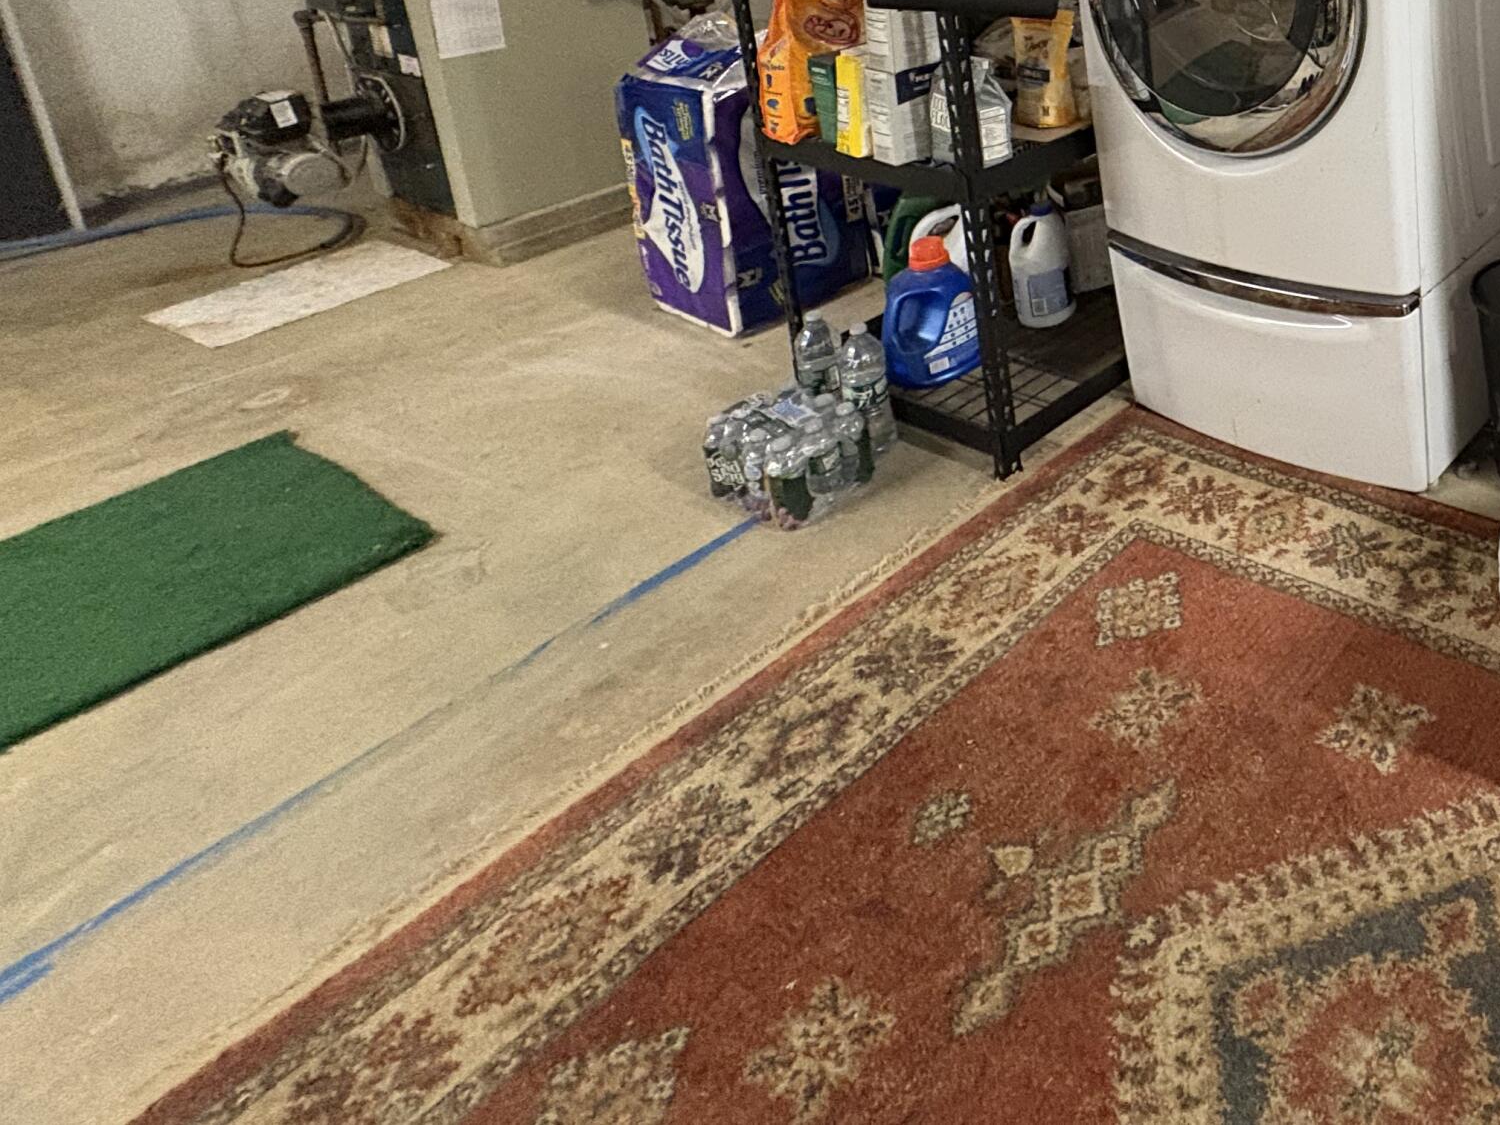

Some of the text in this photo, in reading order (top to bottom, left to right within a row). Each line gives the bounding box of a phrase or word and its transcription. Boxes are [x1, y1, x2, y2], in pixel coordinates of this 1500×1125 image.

[642, 115, 679, 194] Bath
[658, 193, 692, 288] Tissue
[783, 190, 828, 263] Bath
